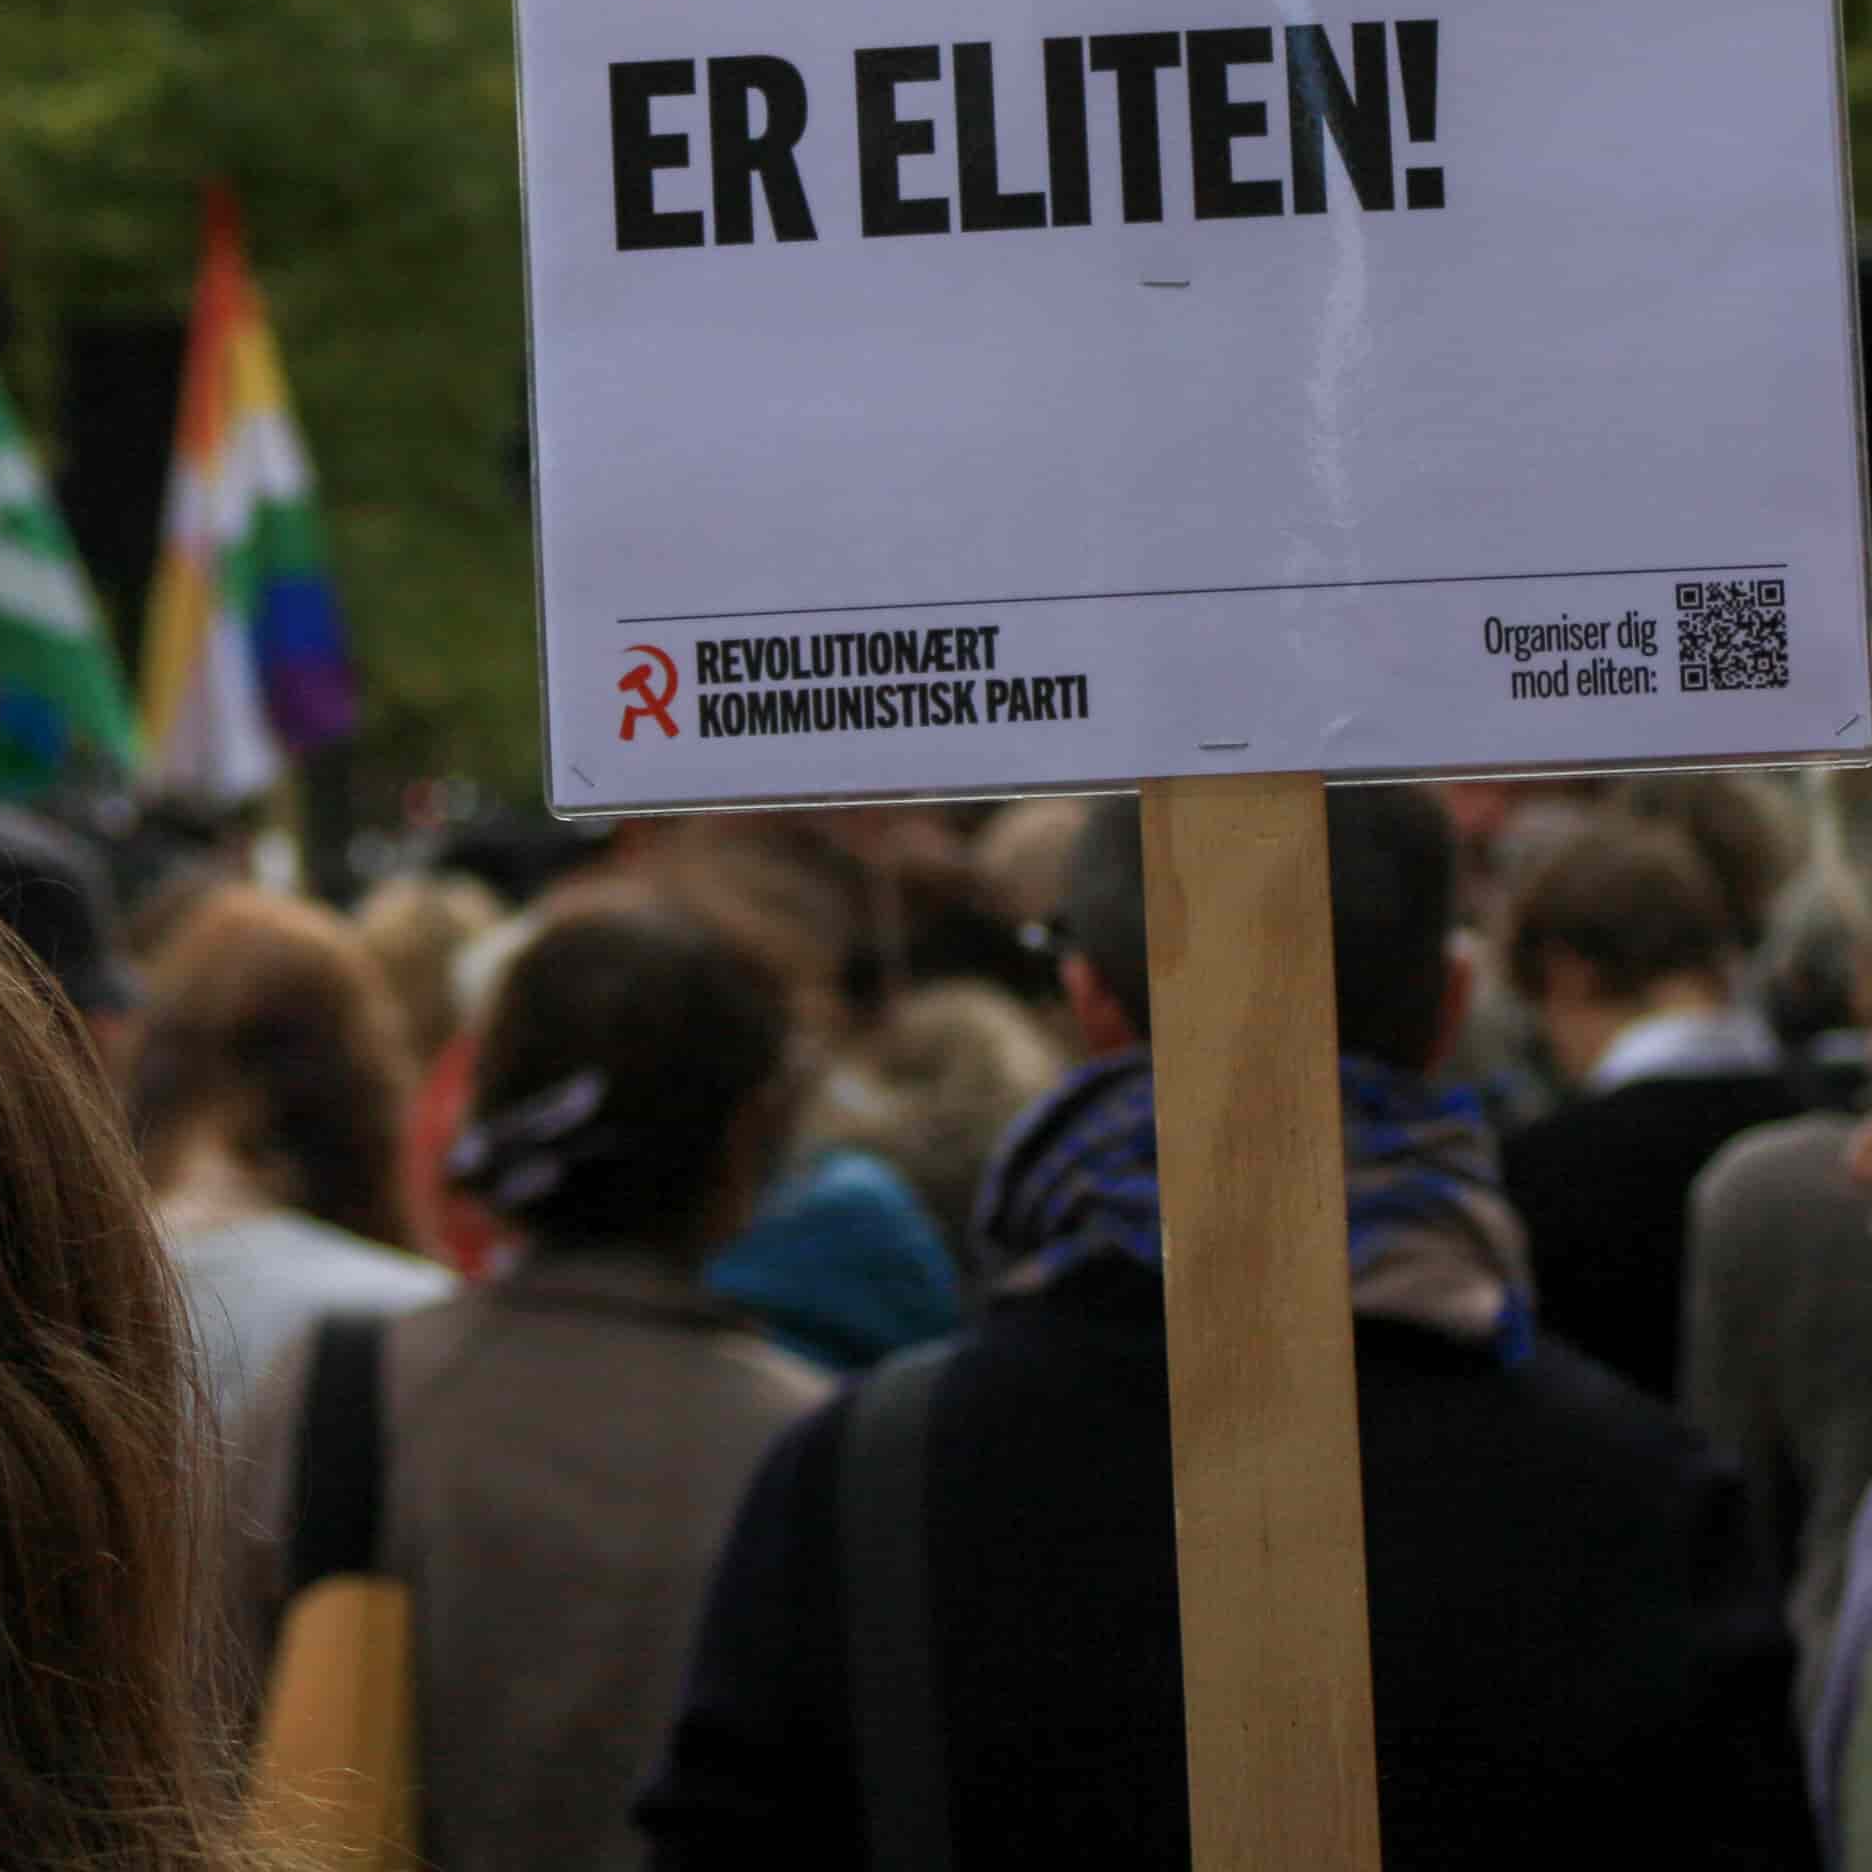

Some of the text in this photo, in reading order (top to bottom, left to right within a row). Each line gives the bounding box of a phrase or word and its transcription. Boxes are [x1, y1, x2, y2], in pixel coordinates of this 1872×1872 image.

[609, 19, 1446, 252] ER ELITEN!
[695, 625, 1000, 685] REVOLUTIONÆRT
[1483, 610, 1659, 663] Organiser dig
[698, 673, 1090, 739] KOMMUNISTISK PARTI
[1511, 656, 1658, 700] mod eliten:
